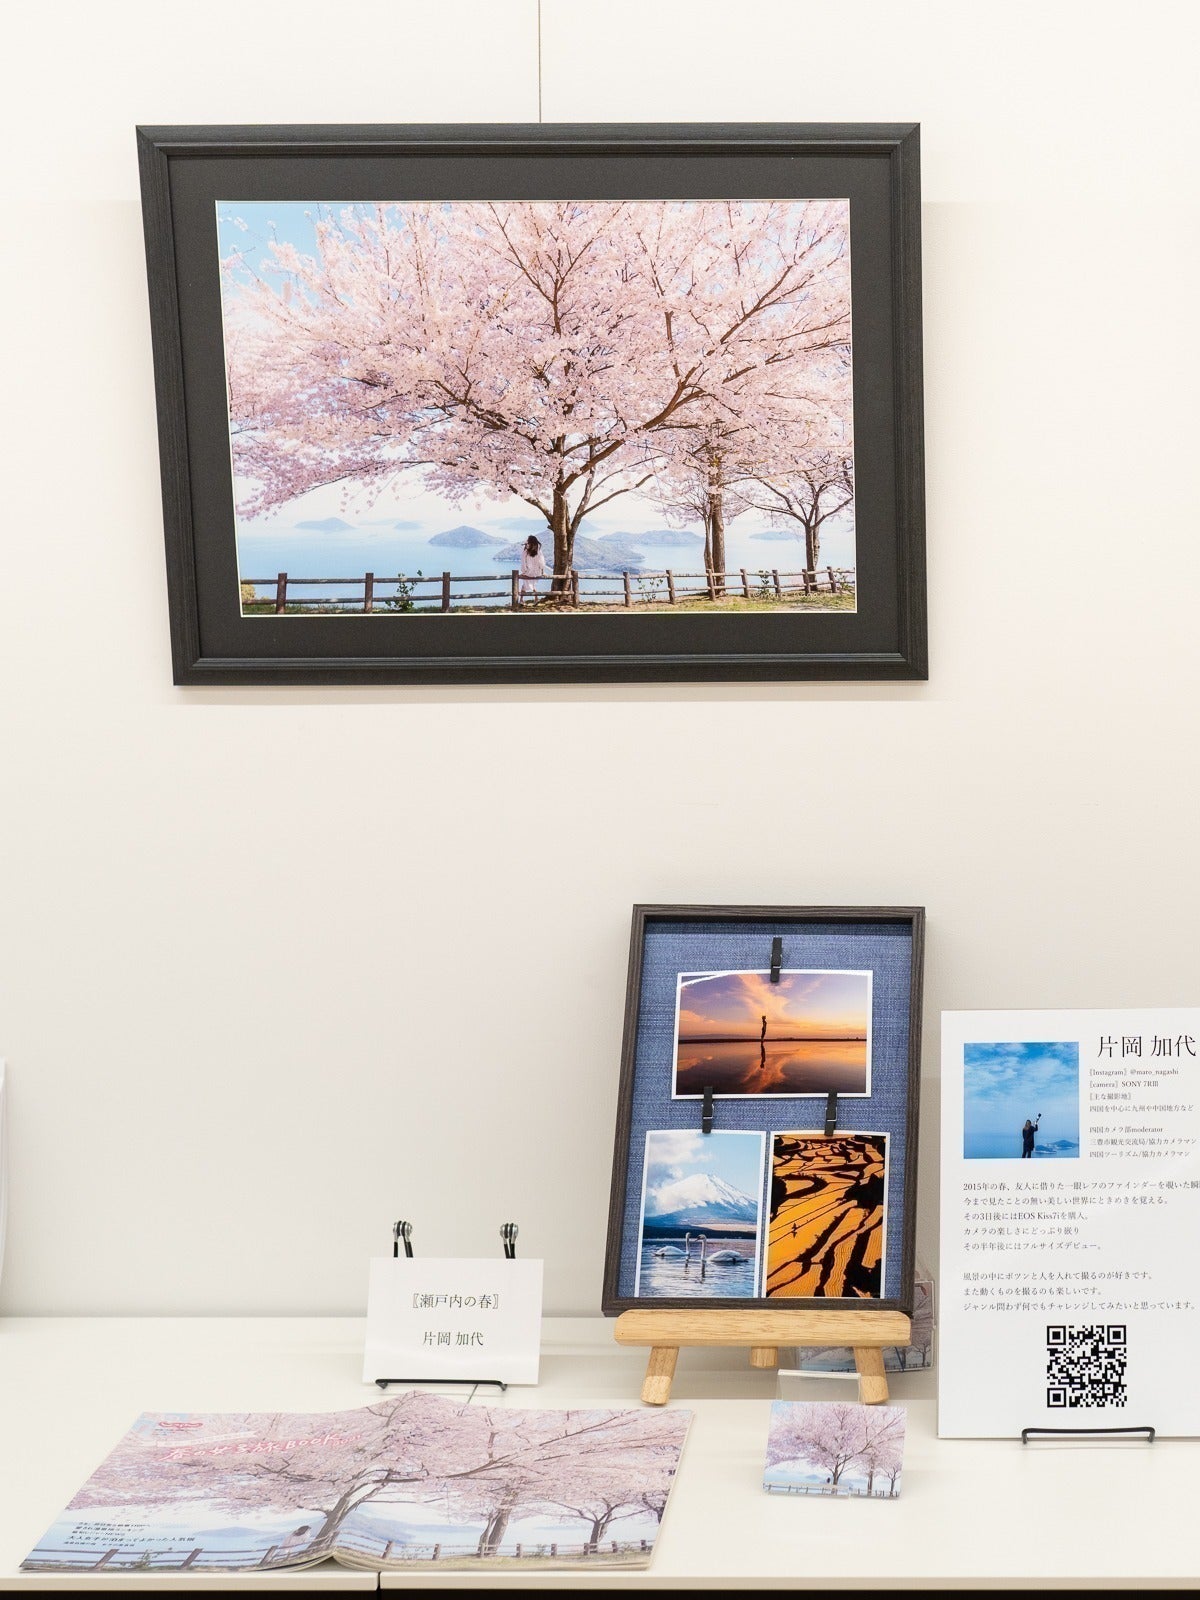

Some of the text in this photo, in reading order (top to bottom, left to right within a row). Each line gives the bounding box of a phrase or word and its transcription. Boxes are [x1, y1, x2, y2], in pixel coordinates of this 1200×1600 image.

[1097, 1035, 1197, 1058] 片岡 加代
[1121, 1080, 1141, 1088] SONY
[423, 1331, 484, 1346] 片岡 加代
